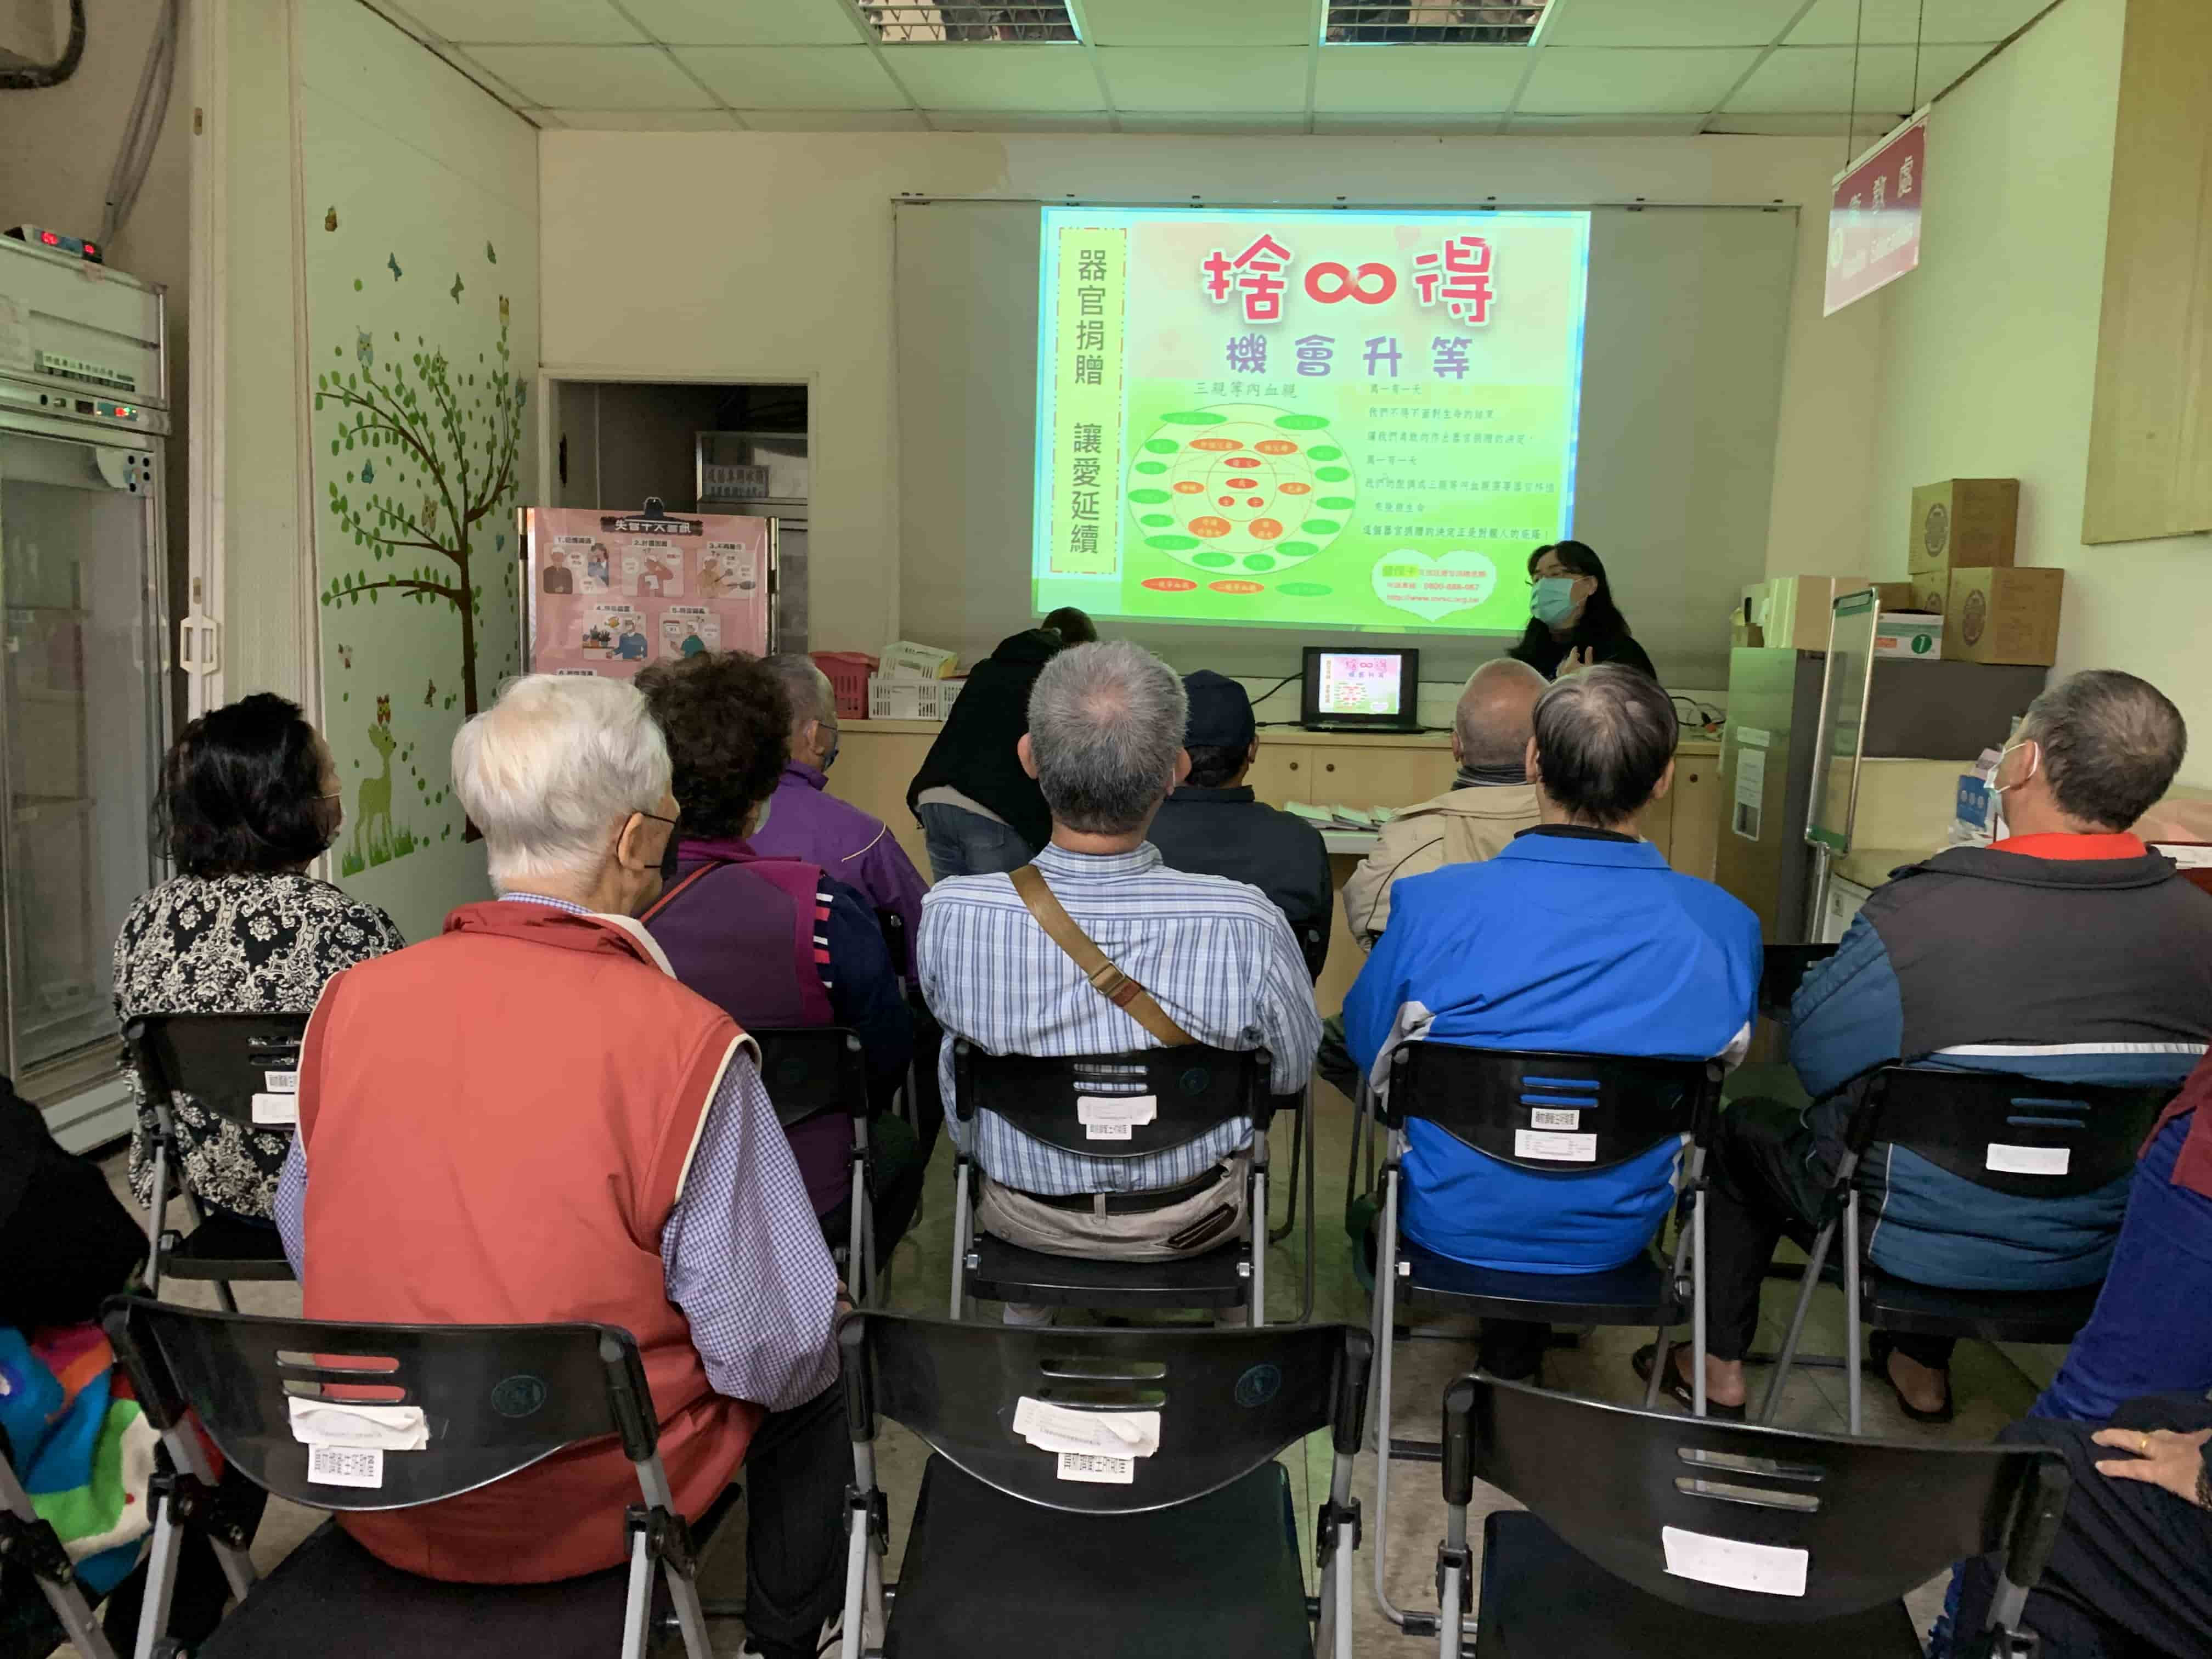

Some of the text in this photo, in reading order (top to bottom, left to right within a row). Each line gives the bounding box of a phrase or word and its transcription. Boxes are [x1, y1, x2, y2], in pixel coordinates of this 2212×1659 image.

[1070, 250, 1107, 554] 器官捐贈 讓愛延續
[1226, 333, 1473, 379] 機會升等
